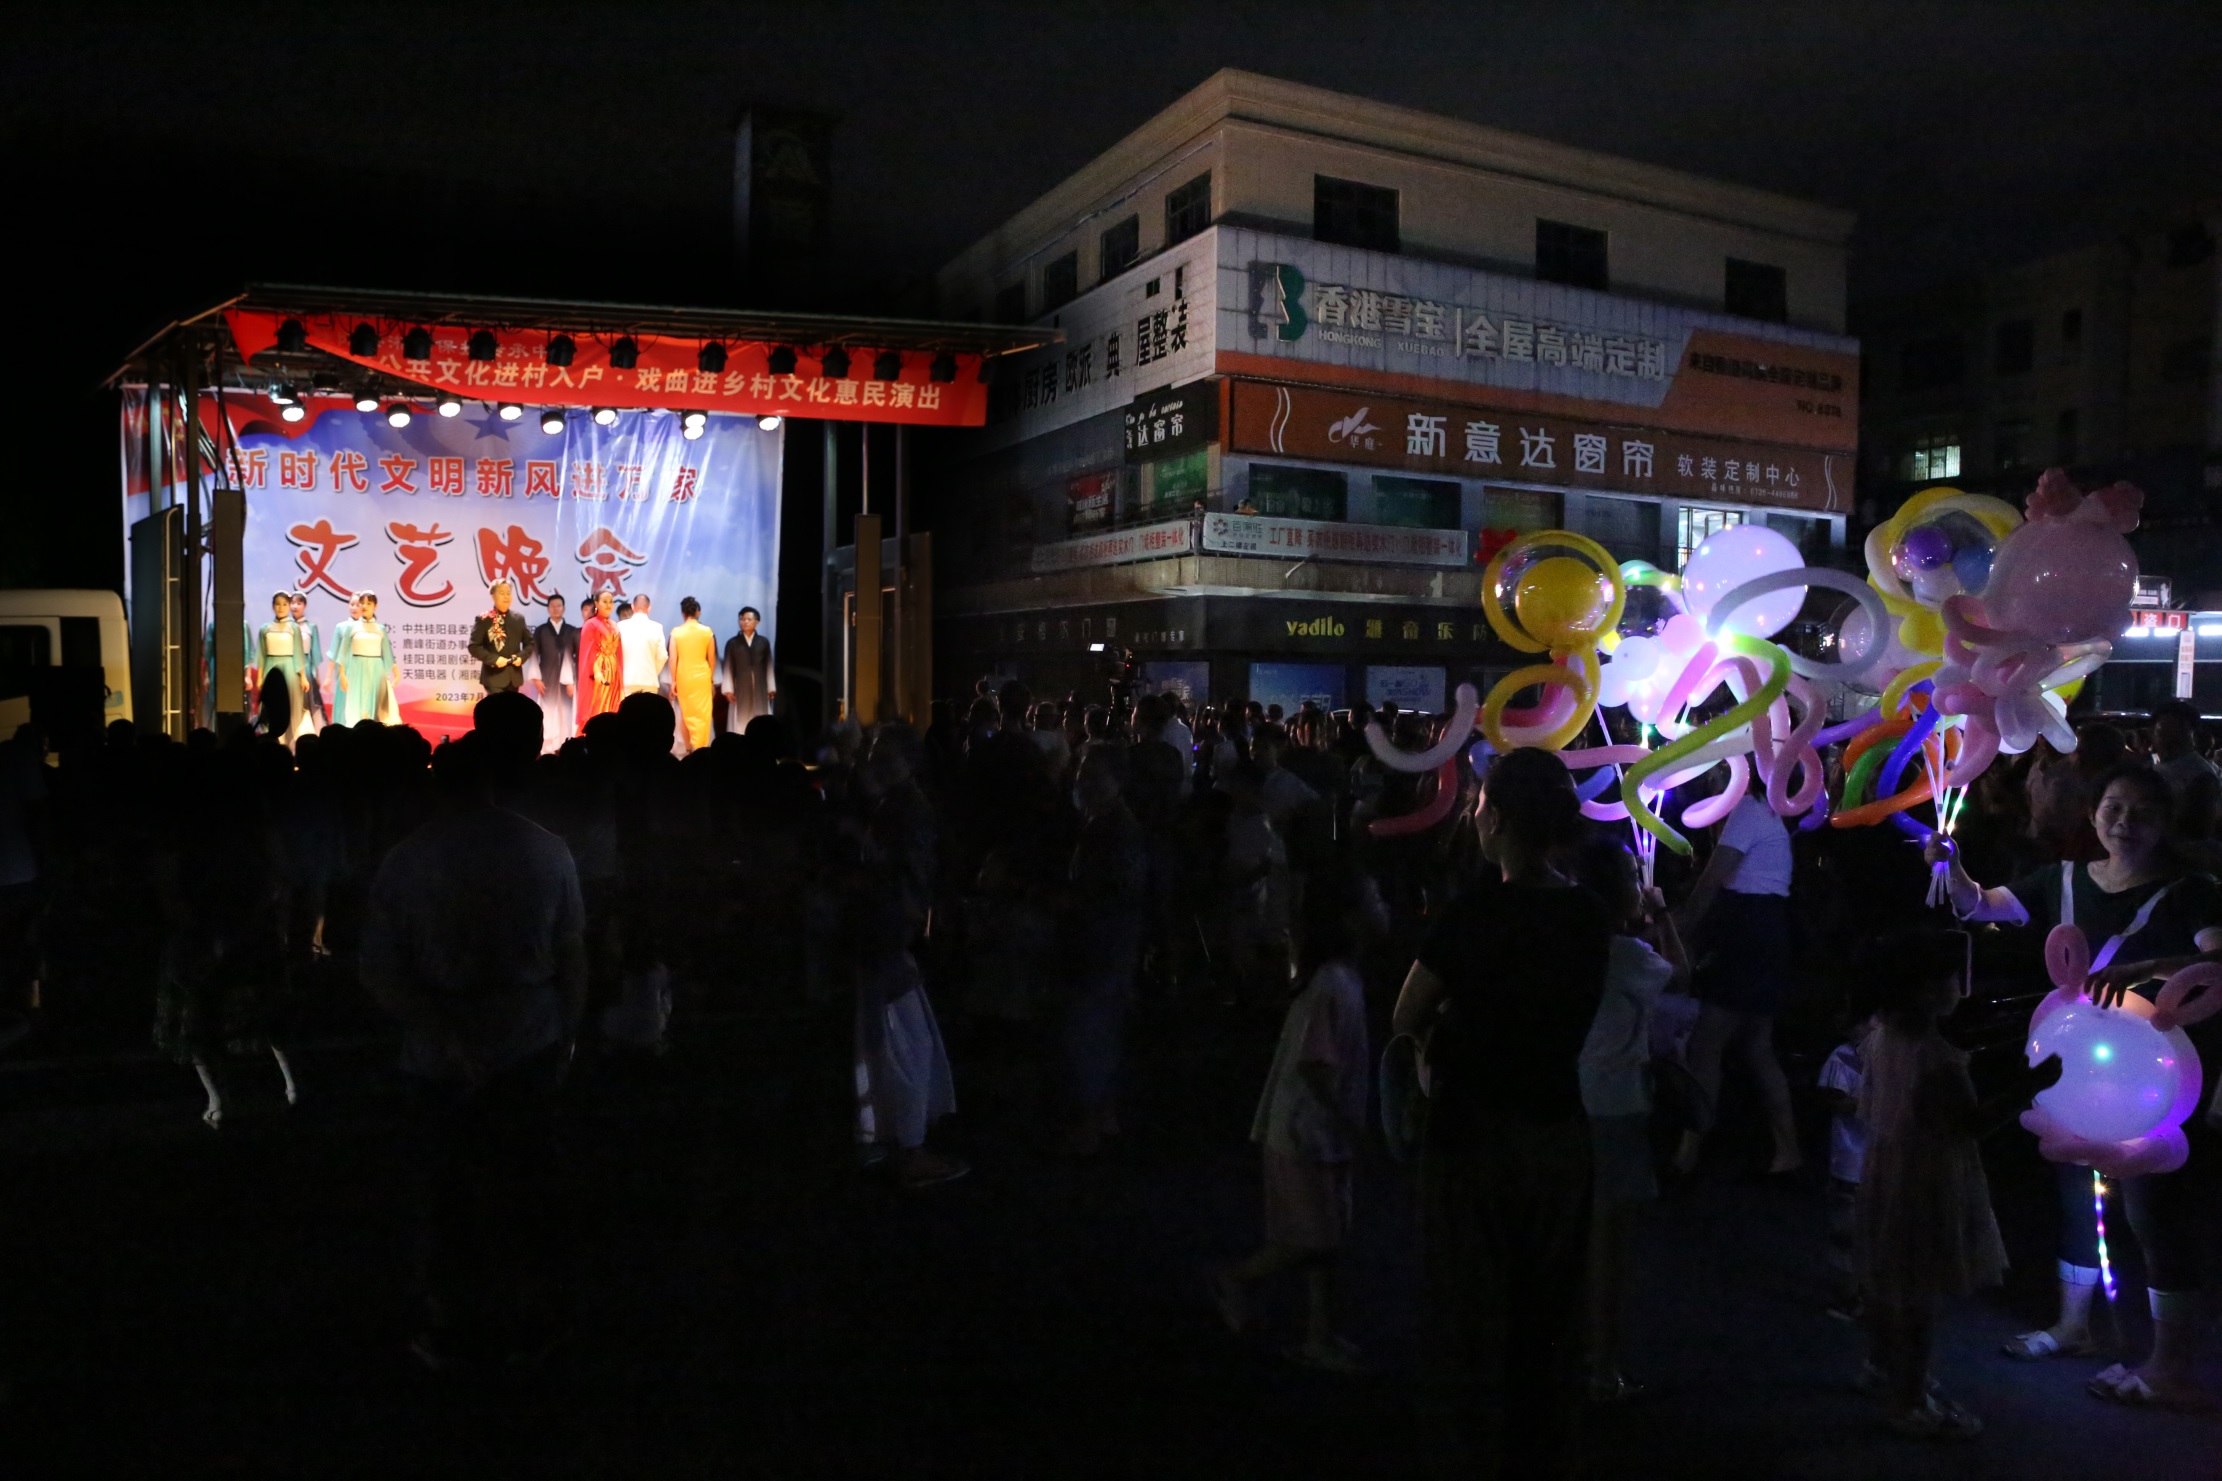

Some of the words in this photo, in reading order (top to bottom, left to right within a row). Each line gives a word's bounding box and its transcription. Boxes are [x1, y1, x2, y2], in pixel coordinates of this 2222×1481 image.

[1315, 285, 1446, 342] 香港雪宝
[1466, 313, 1665, 382] 全屋高端定制
[1318, 329, 1383, 350] HONGKONG
[1396, 341, 1446, 359] XUEBAO
[1024, 361, 1058, 412] 厨房
[1406, 411, 1655, 479] 新意达窗帘
[1677, 453, 1800, 487] 软装定制中心
[228, 448, 697, 502] 新时代文明新风进万家
[288, 519, 646, 603] 文艺晚会
[1286, 615, 1345, 637] yadilo
